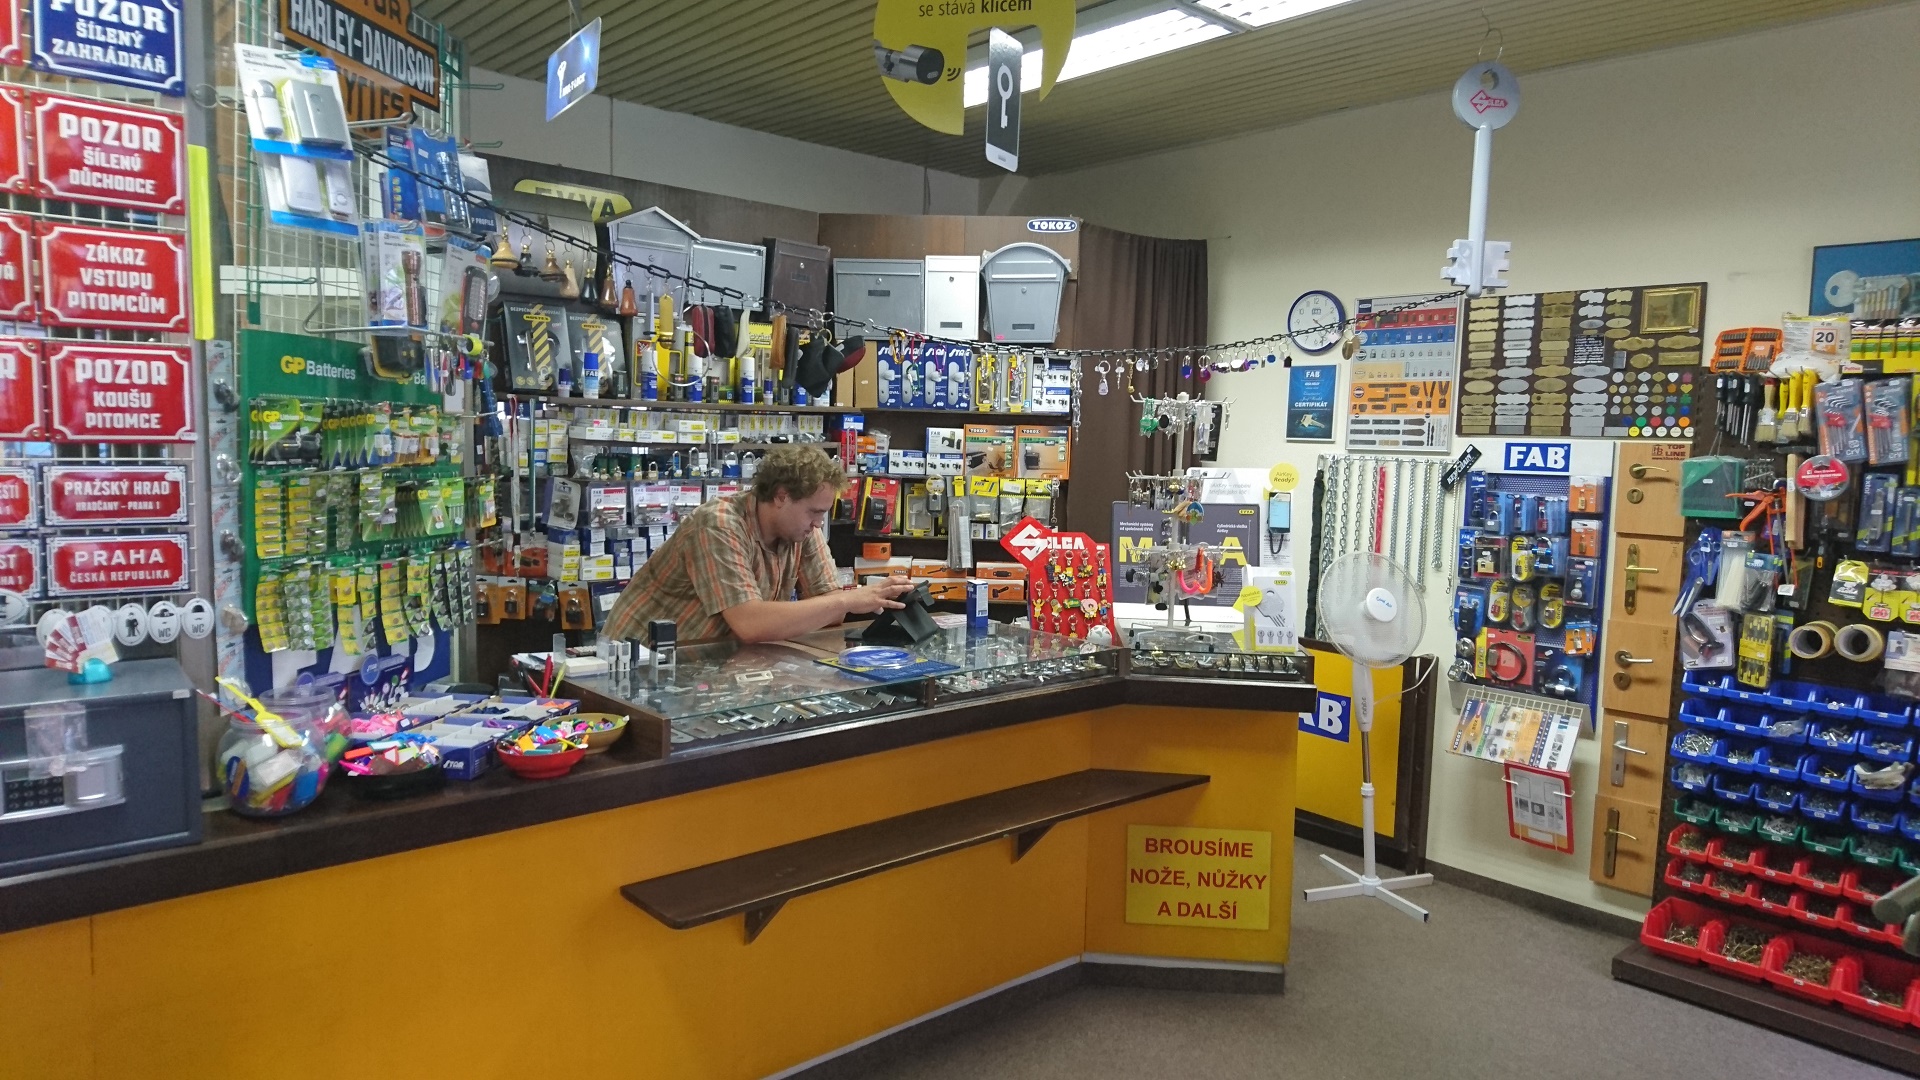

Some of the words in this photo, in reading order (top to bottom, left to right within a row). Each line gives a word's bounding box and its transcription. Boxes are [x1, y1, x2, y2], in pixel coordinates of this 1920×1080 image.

[919, 4, 933, 17] se
[938, 0, 975, 16] stává
[76, 19, 145, 49] ŠÍLENÝ
[52, 38, 167, 74] ZAHRÁDKÁŘ
[291, 0, 435, 95] HARLEY-DAVIDSON
[58, 112, 162, 153] POZOR
[69, 167, 157, 196] DŮCHODCE
[1032, 221, 1070, 230] TOKOZ
[85, 242, 146, 266] ZÁKAZ
[79, 267, 153, 290] VSTUPU
[67, 290, 167, 315] PITOMCŮM
[1815, 332, 1835, 343] 20
[75, 357, 168, 386] POZOR
[280, 355, 305, 375] GP
[306, 362, 356, 380] Batteries
[93, 388, 153, 409] KOUŠU
[85, 412, 162, 429] PITOMCE
[1509, 446, 1565, 469] FAB
[64, 480, 130, 496] PRAŽSKÝ
[133, 481, 170, 496] HRAD
[75, 501, 119, 512] HRADČANY
[128, 502, 153, 511] PRAHA
[74, 549, 164, 567] PRAHA
[69, 570, 105, 583] ČESKÁ
[110, 569, 170, 582] REPUBLIKA
[158, 628, 171, 638] WC
[191, 624, 204, 634] WC
[1145, 838, 1254, 858] BROUSÍME
[1130, 867, 1191, 889] NOŽE,
[1197, 869, 1267, 890] NŮŽKY
[1157, 901, 1172, 916] A
[1177, 901, 1237, 919] DALŠÍ
